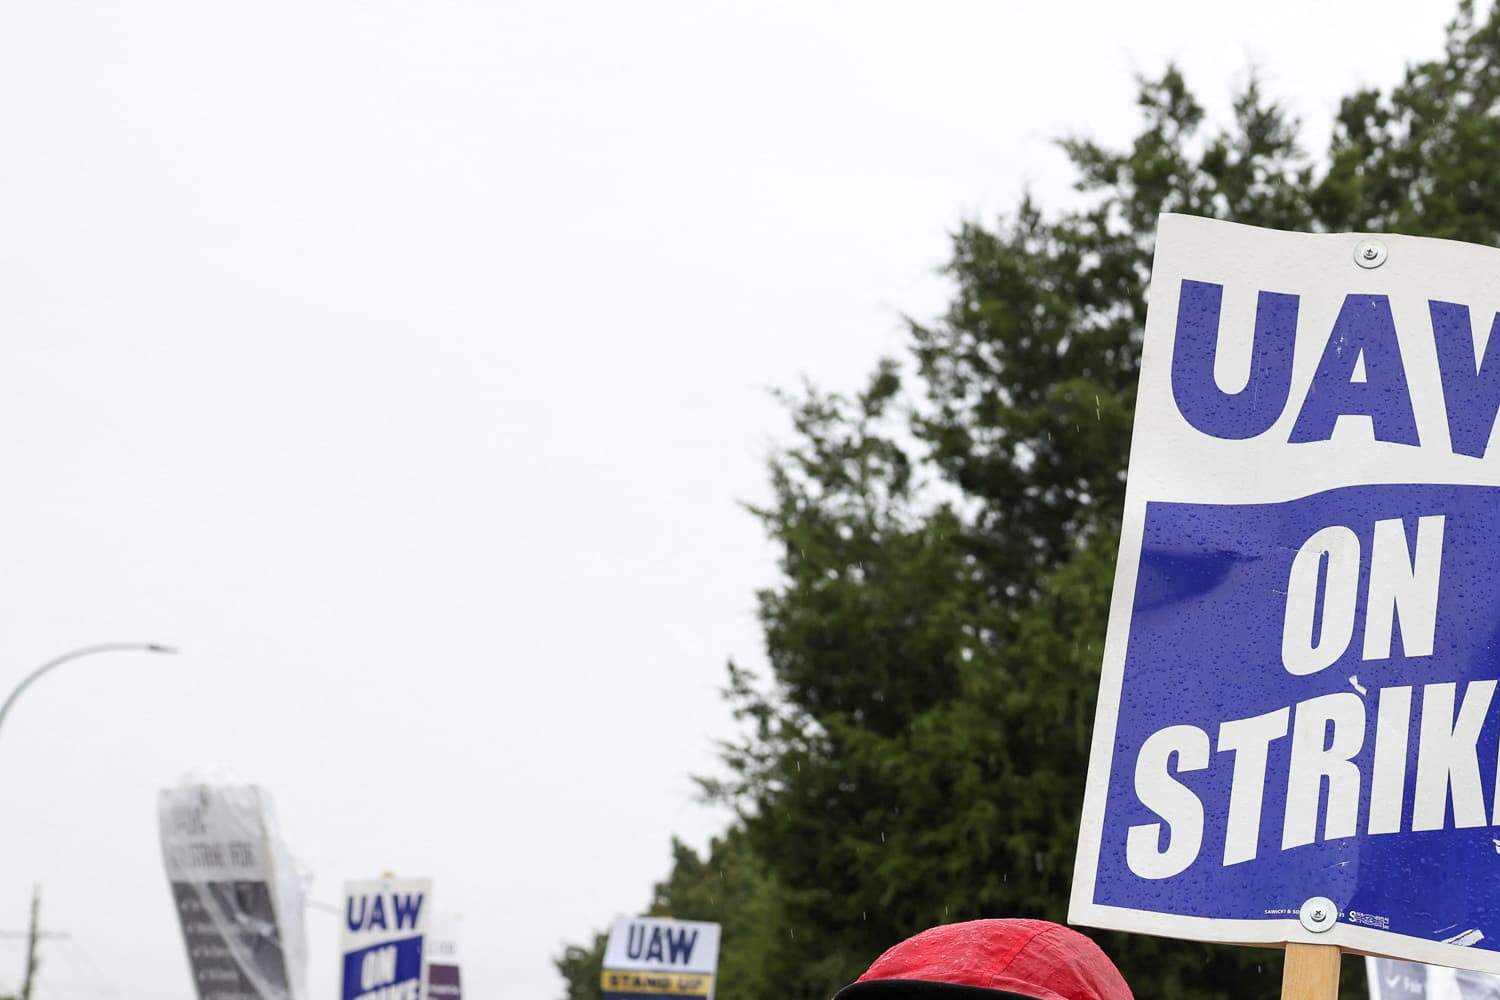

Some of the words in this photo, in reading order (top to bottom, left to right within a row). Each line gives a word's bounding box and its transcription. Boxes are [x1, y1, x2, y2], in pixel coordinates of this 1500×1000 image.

[1281, 515, 1446, 676] ON
[347, 892, 425, 932] UAW
[627, 923, 698, 966] UAW
[360, 944, 398, 991] ON
[609, 974, 671, 989] STAND
